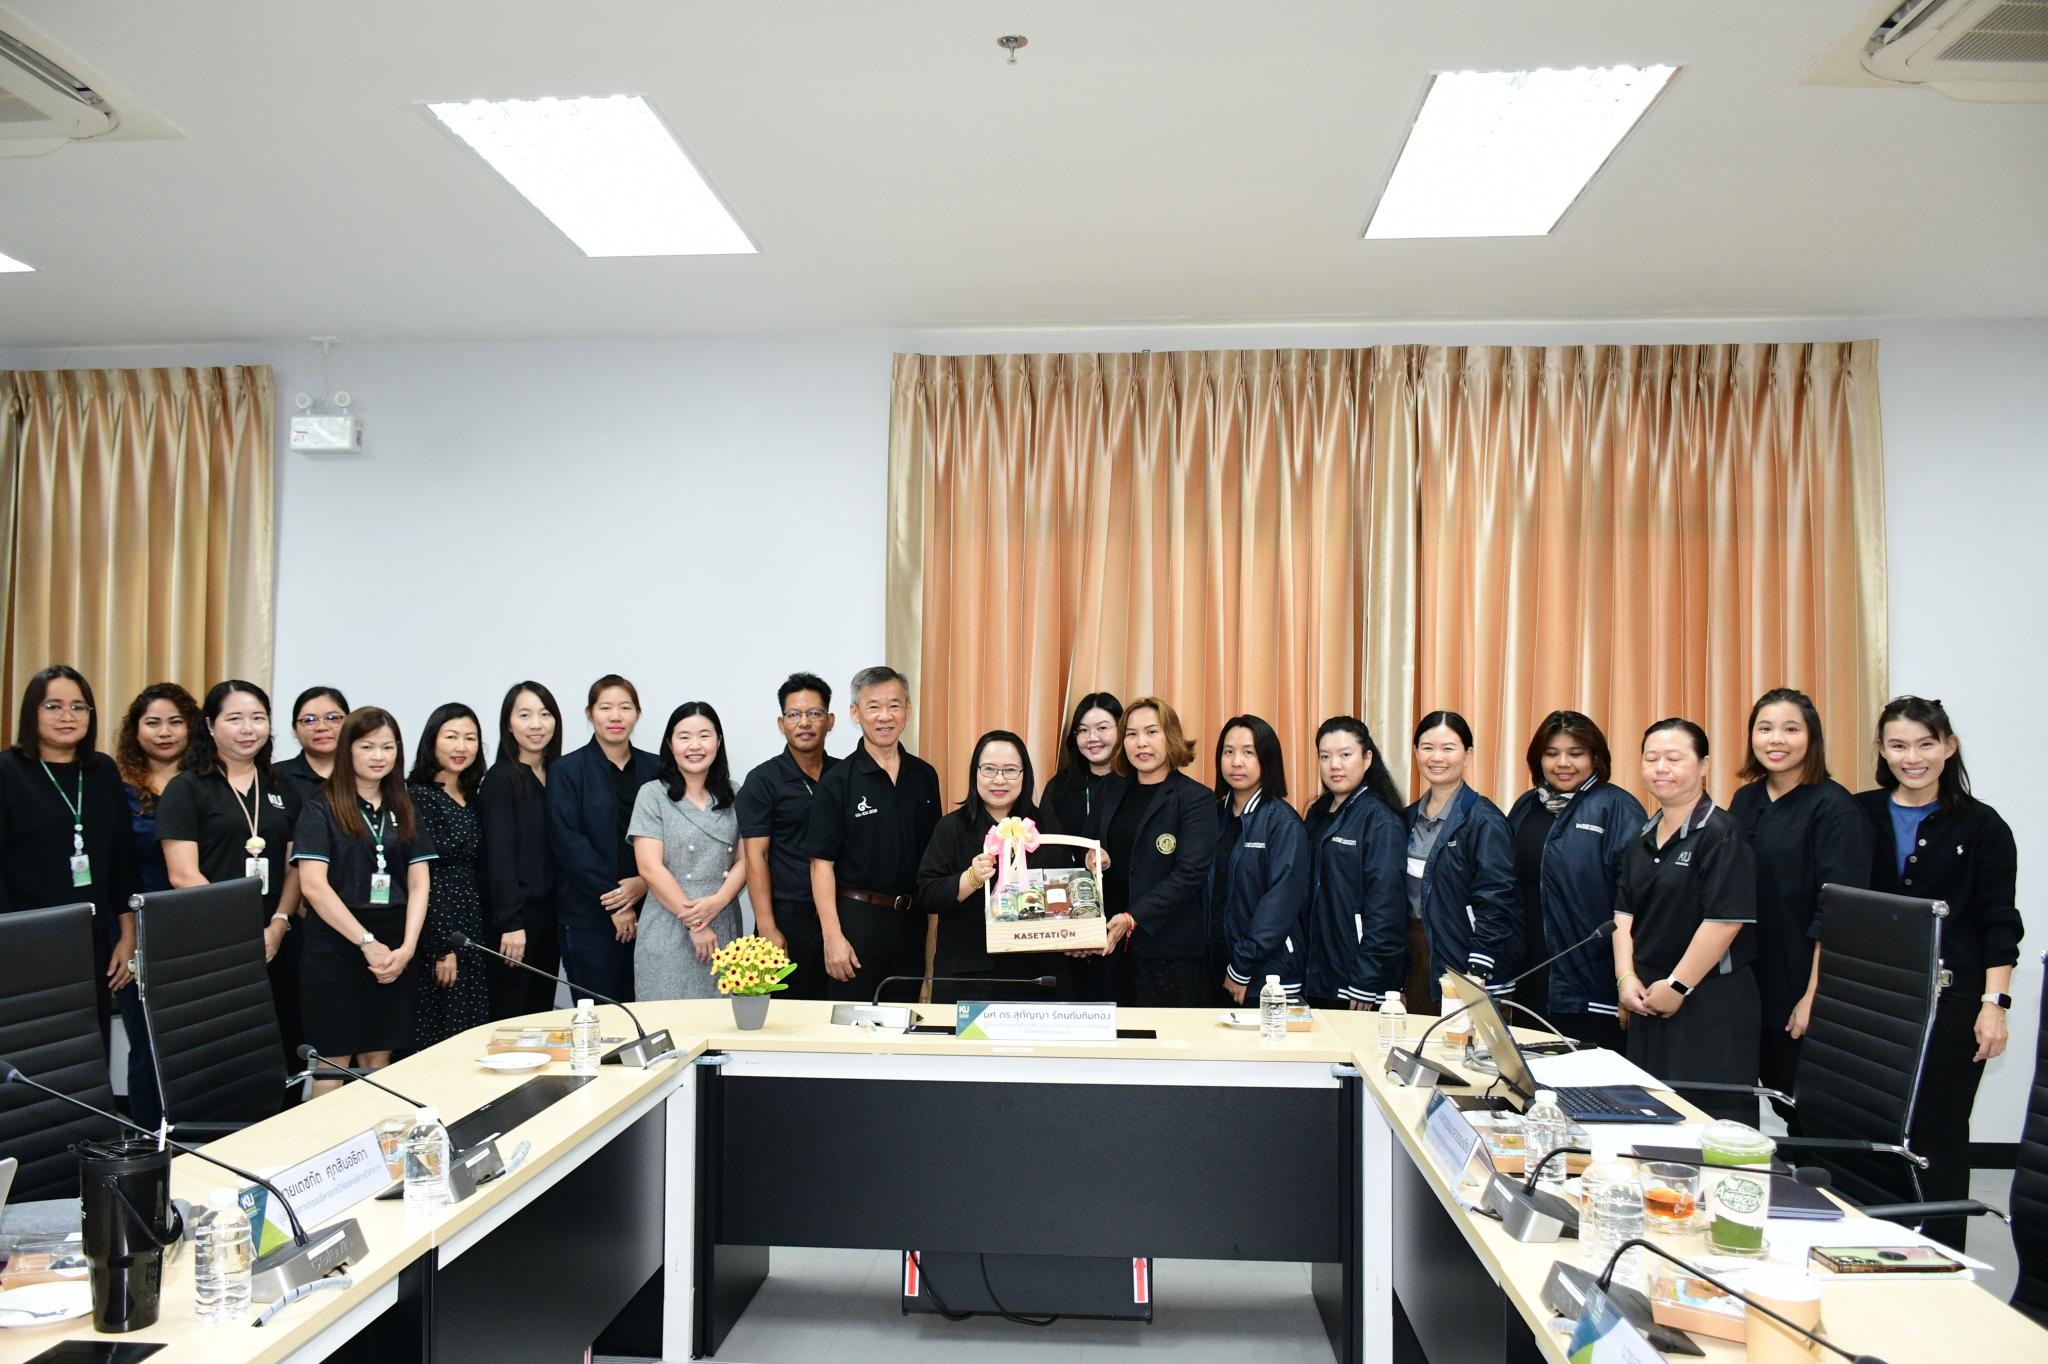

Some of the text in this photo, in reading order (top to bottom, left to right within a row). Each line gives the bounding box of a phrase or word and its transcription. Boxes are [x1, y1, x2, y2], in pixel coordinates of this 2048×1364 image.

[1677, 851, 1692, 862] KU
[958, 1005, 970, 1013] KU
[241, 1193, 255, 1209] KU
